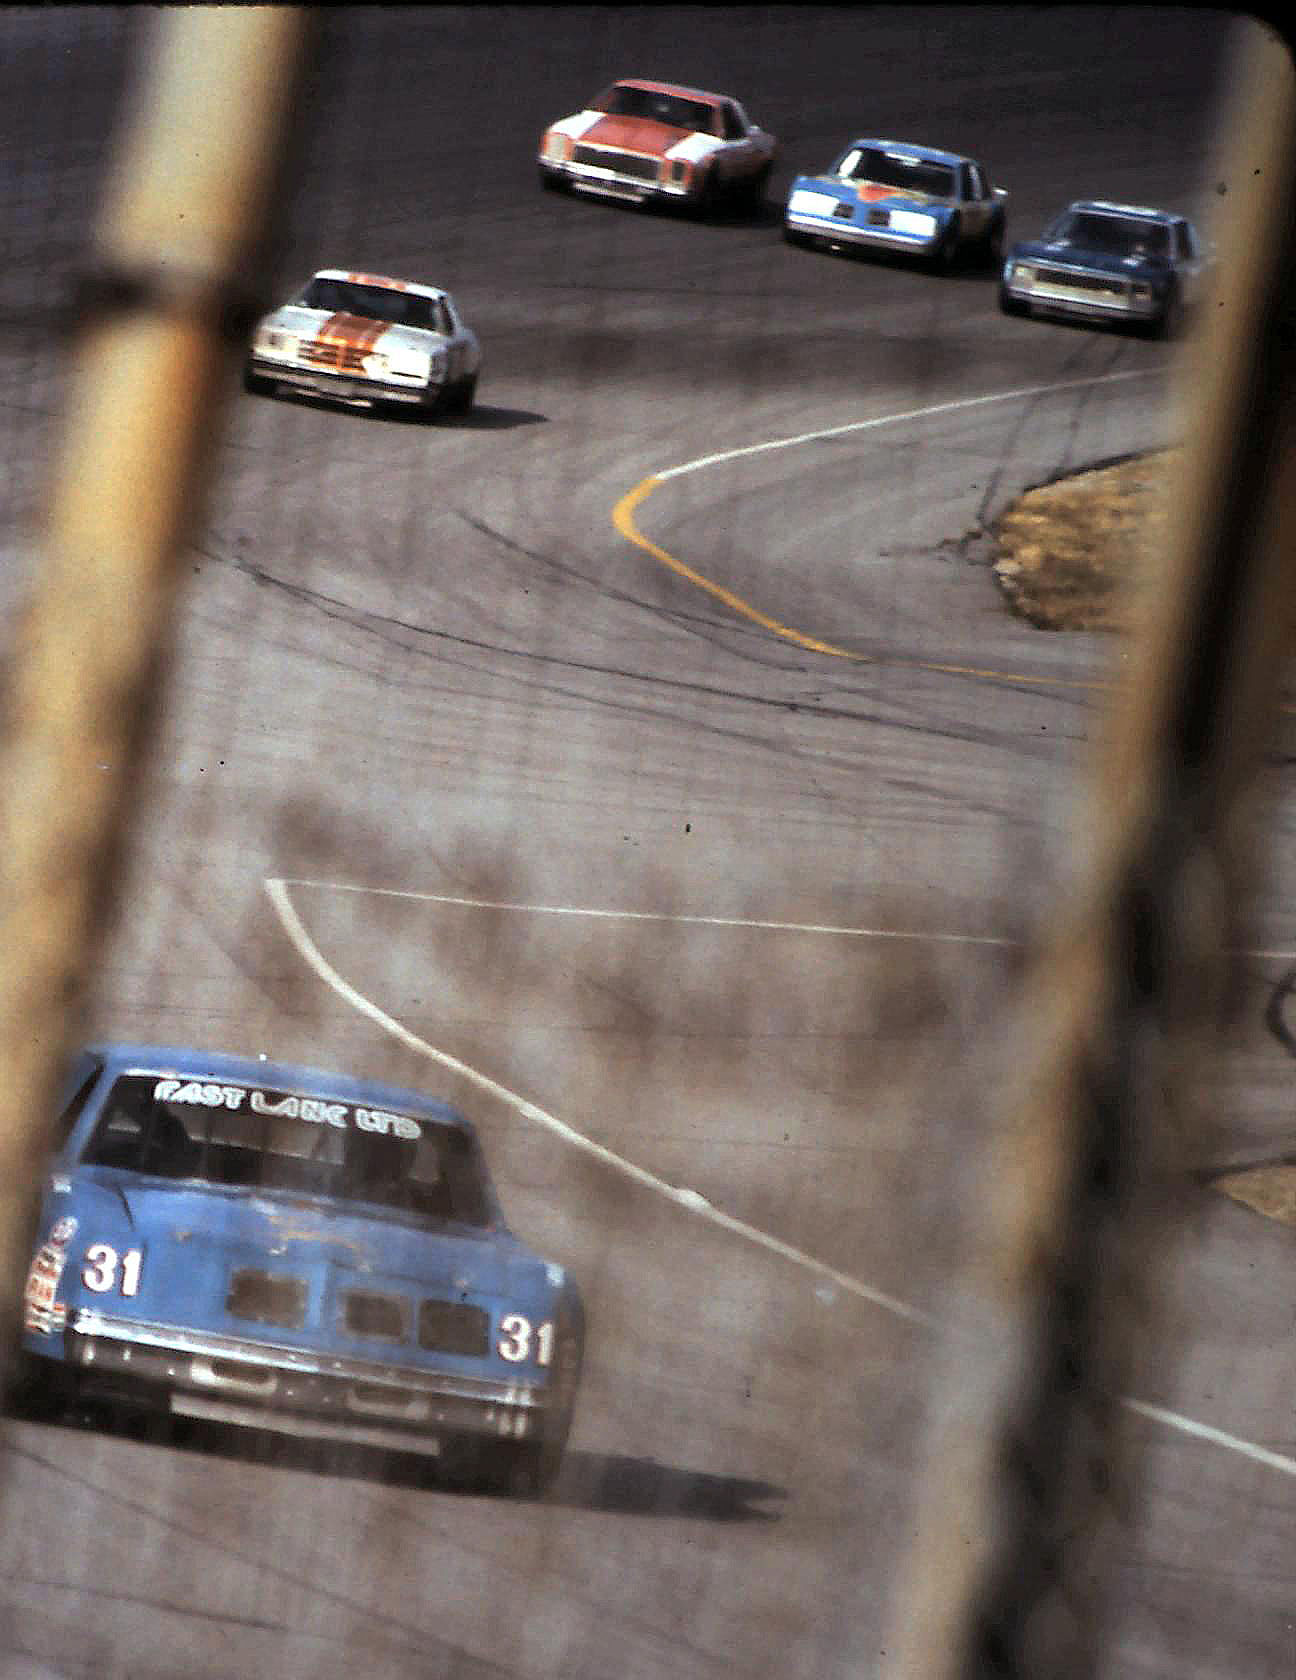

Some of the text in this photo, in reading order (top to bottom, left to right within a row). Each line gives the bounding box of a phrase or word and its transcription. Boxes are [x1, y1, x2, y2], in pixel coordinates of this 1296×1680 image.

[154, 1080, 423, 1140] FAST LANE LTD
[83, 1244, 142, 1297] 31
[498, 1314, 554, 1365] 31
